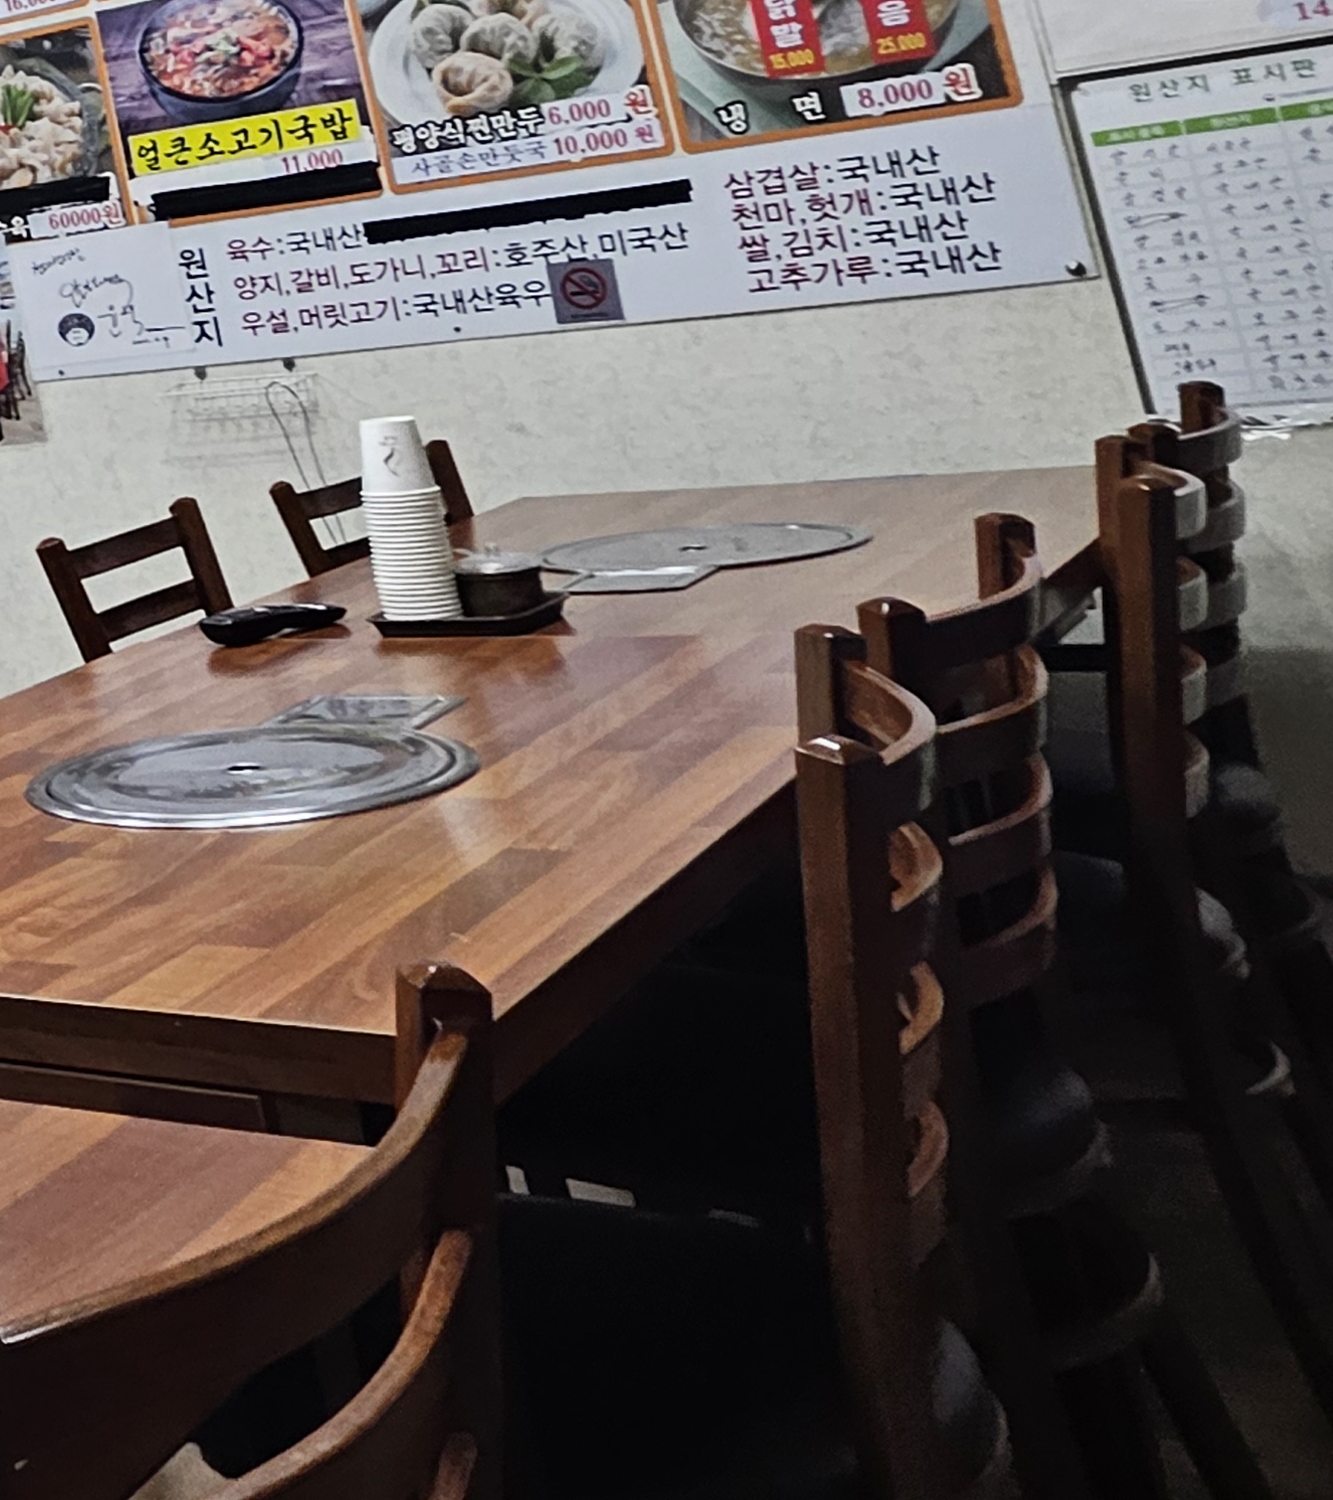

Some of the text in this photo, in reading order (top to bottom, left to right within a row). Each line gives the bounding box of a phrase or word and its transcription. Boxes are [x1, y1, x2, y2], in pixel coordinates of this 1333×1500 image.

[943, 69, 975, 96] 원
[1129, 58, 1316, 104] 원산지 표시판
[137, 107, 353, 171] 얼큰소고기국밥
[391, 105, 545, 153] 평양식찐만두
[624, 88, 654, 116] 원
[747, 241, 1003, 293] 고추가루:국내산
[178, 247, 223, 348] 원산지
